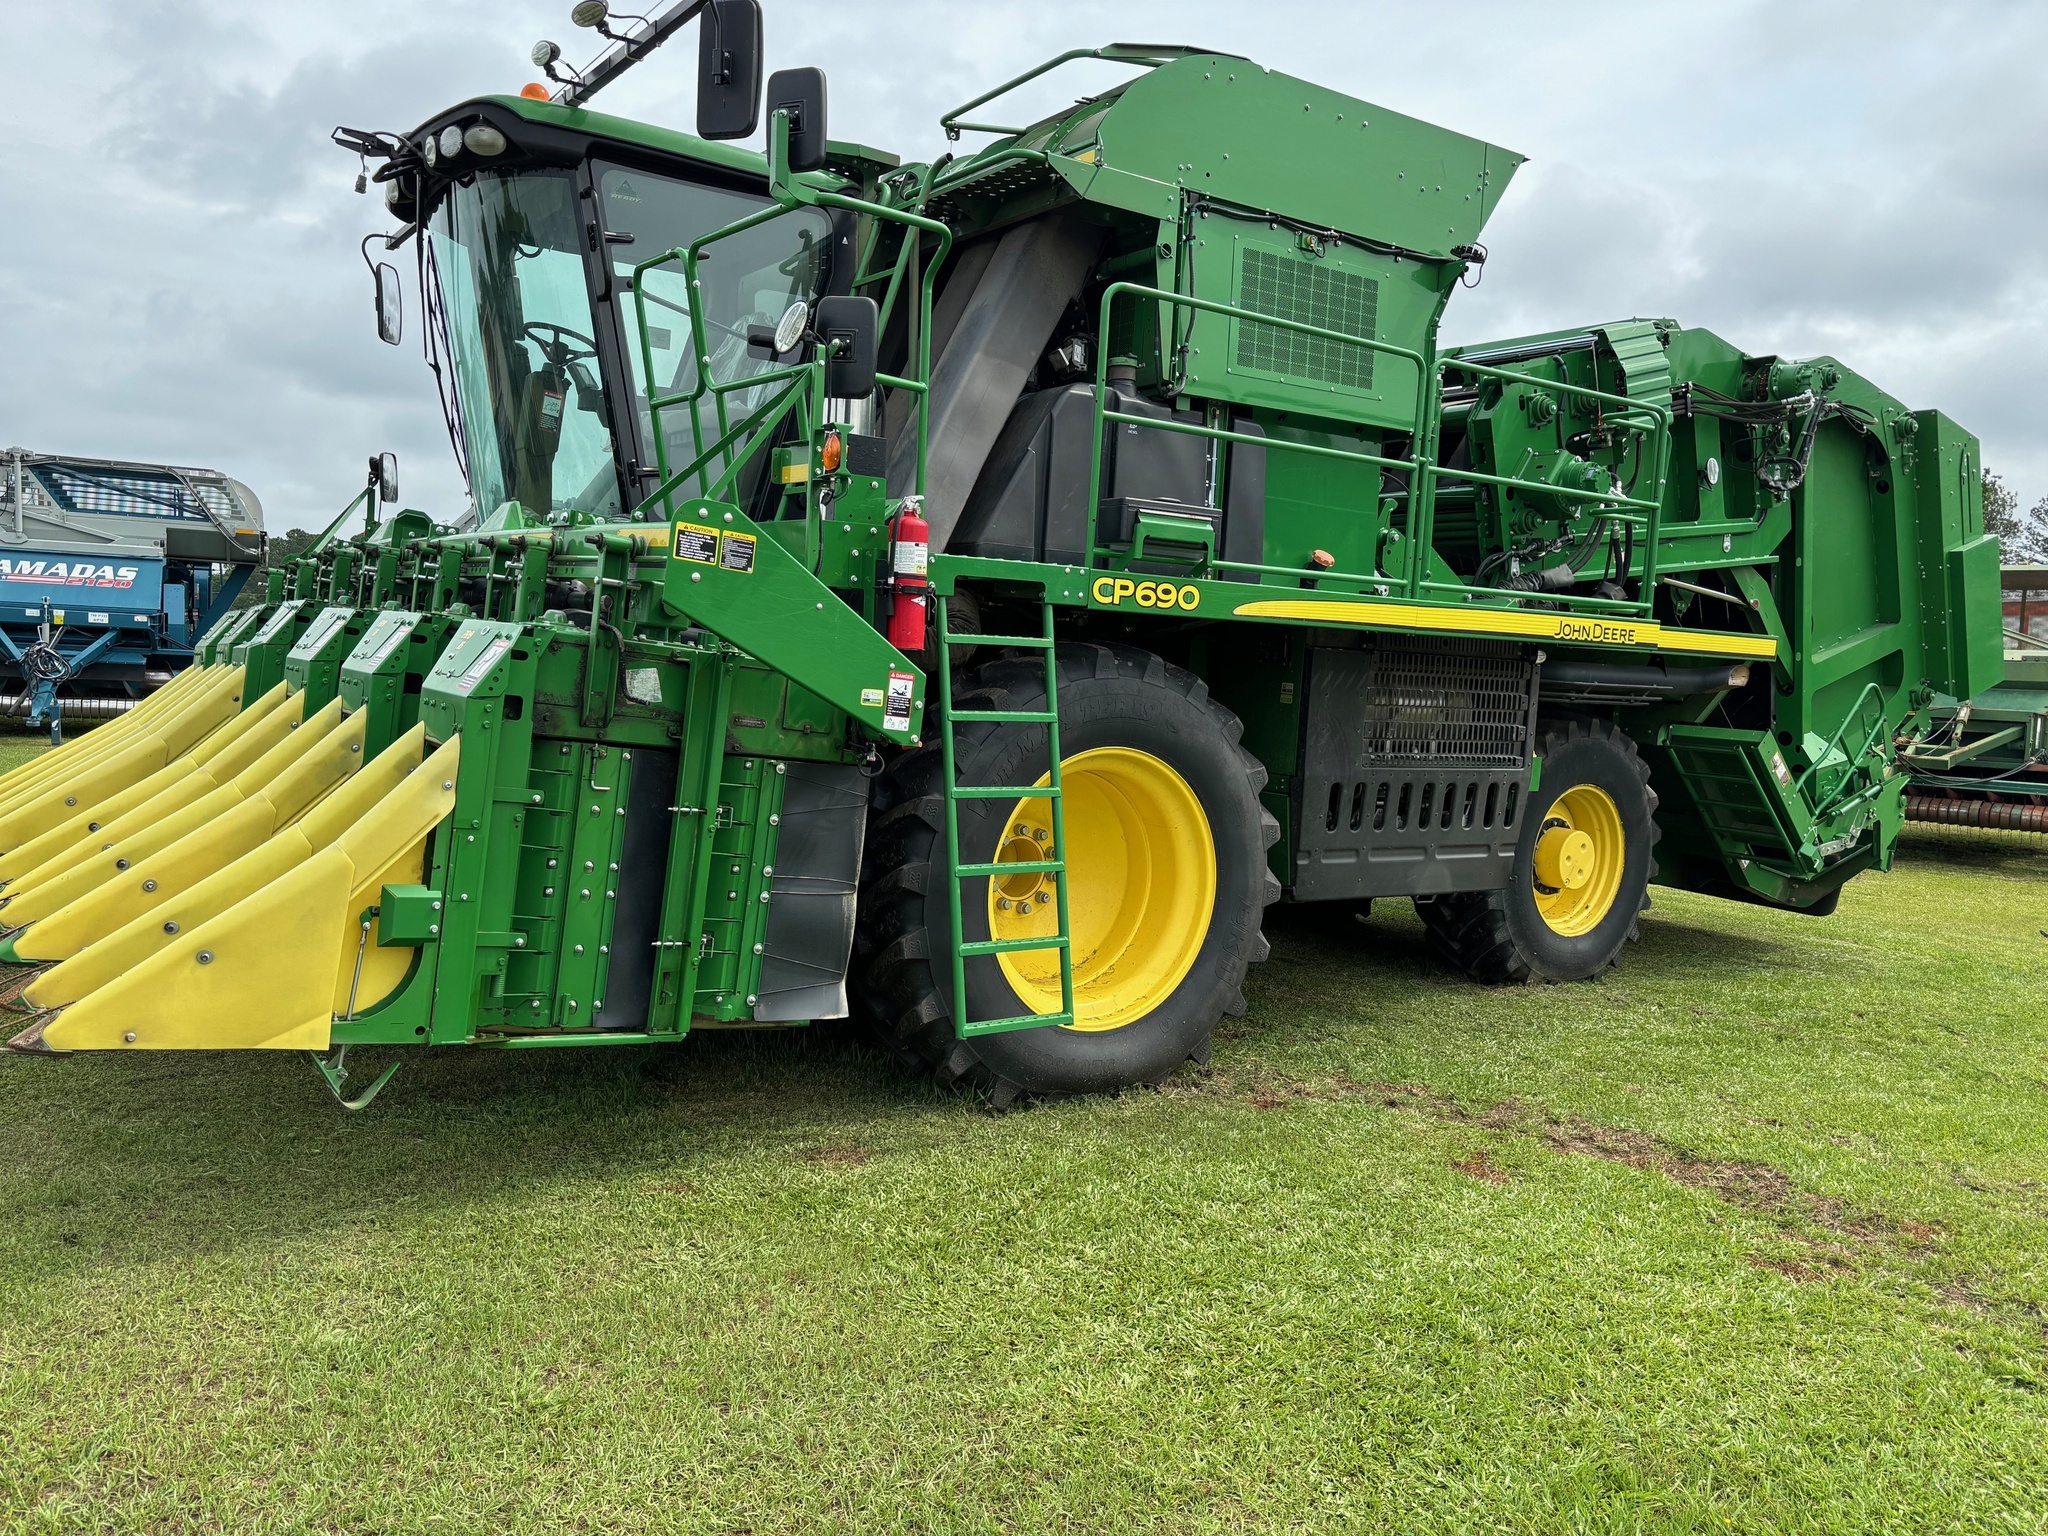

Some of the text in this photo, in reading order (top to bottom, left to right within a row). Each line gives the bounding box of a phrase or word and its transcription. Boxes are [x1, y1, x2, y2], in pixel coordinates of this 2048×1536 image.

[690, 525, 713, 534] CAUTION
[66, 577, 134, 588] 2120
[1092, 576, 1201, 611] CP690
[1554, 620, 1636, 643] JOHN DEERE
[1214, 894, 1256, 988] BKT
